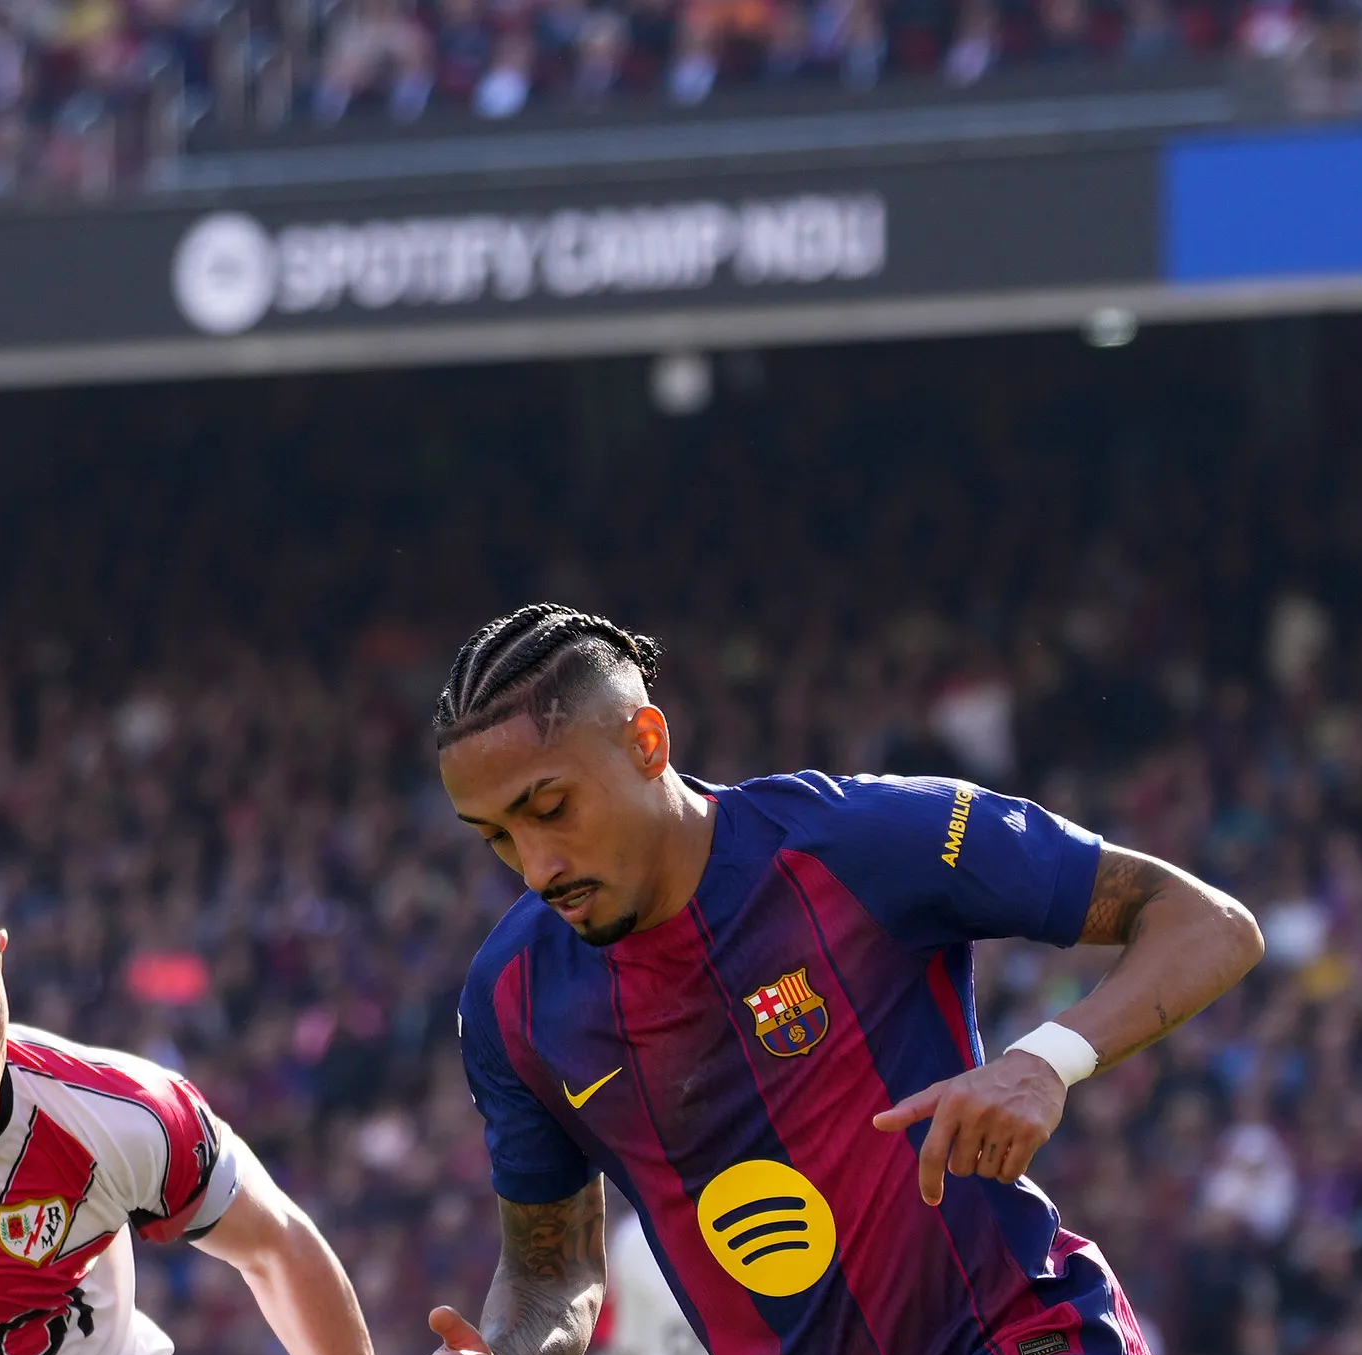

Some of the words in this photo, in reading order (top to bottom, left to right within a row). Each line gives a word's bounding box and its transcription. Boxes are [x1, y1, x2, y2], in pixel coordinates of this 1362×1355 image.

[272, 212, 540, 314] SPOTIFY
[540, 198, 736, 298] CAMP
[740, 190, 888, 286] NOU
